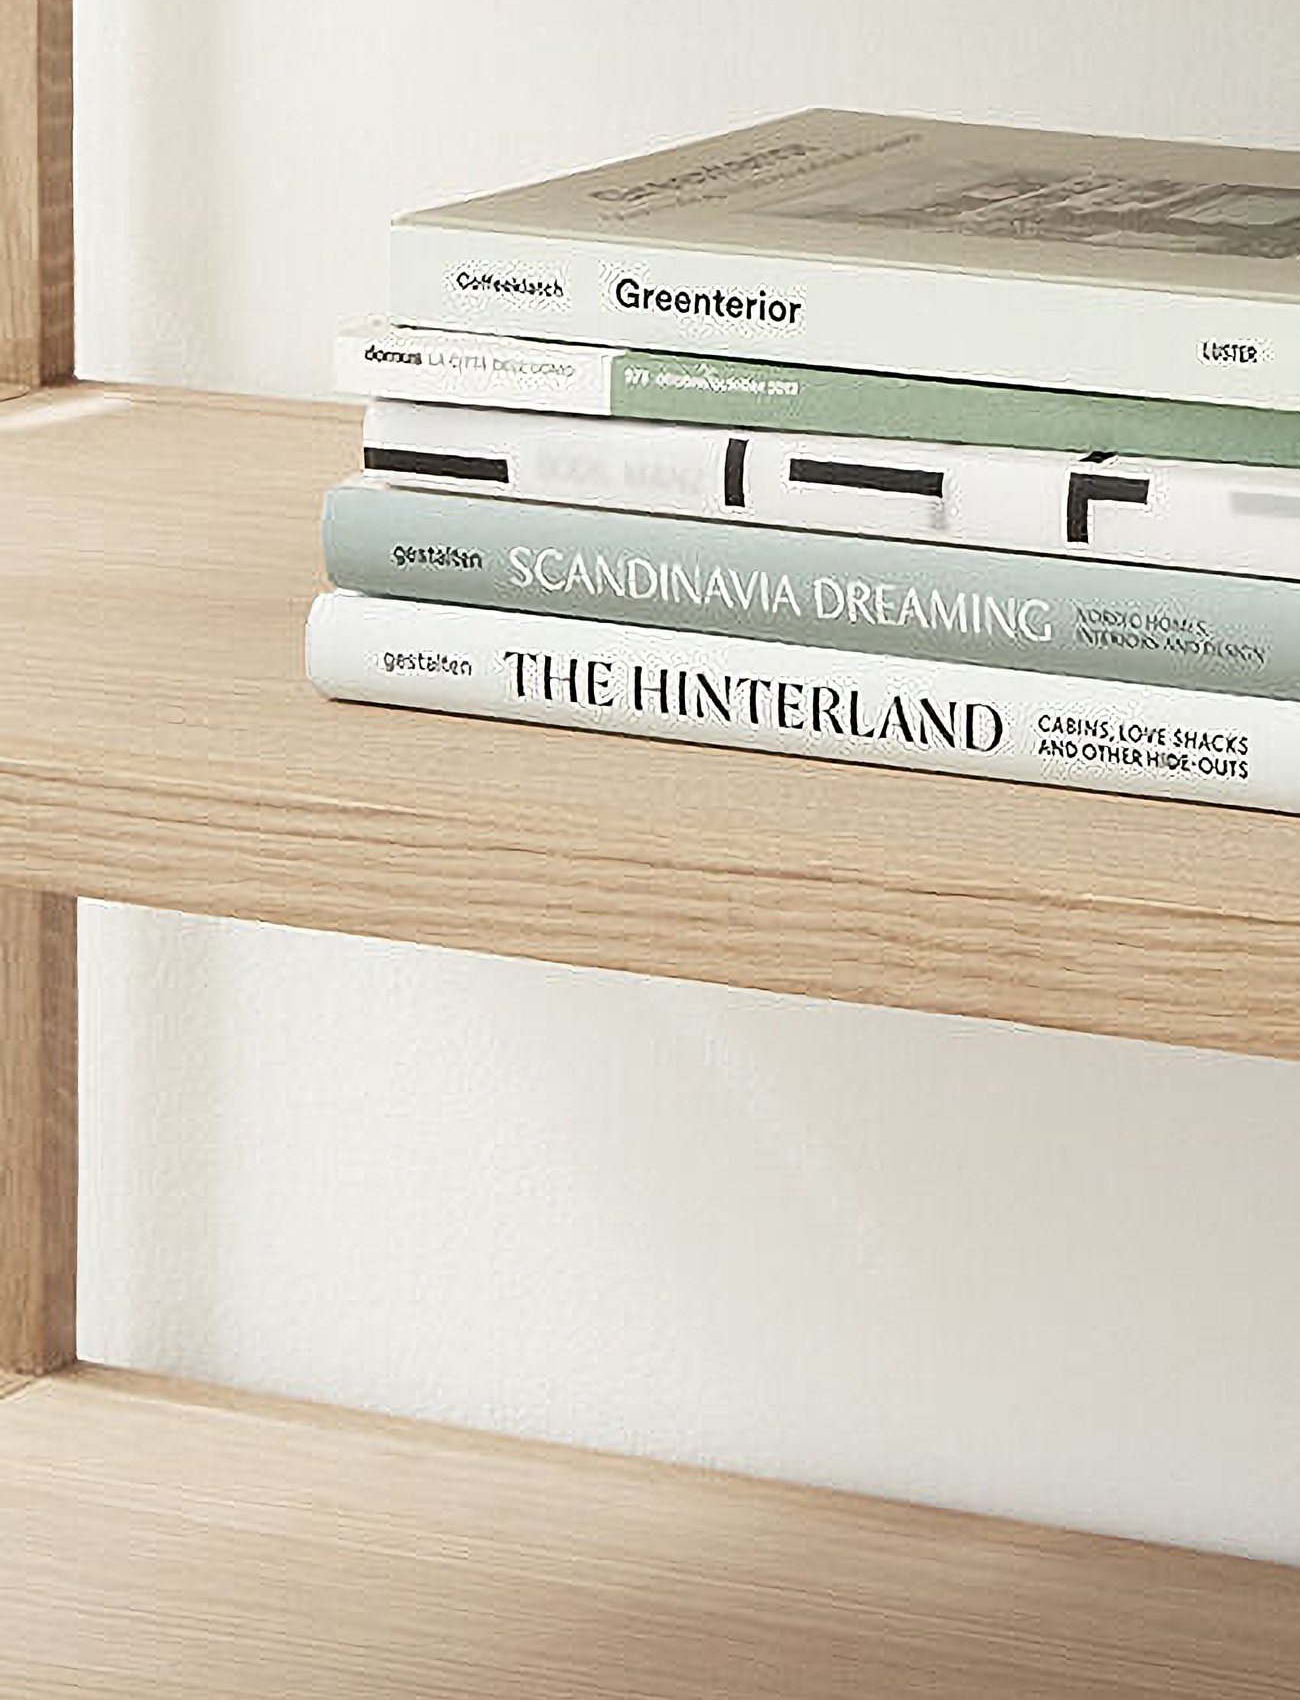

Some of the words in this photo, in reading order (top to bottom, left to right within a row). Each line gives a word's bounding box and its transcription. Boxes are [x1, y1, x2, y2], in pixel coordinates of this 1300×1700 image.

[615, 277, 802, 324] Greenterior
[1202, 341, 1258, 363] LUSTER
[393, 545, 483, 569] gestalten
[509, 545, 802, 617] SCANDINAVIA
[814, 577, 1053, 643] DREAMING
[384, 651, 472, 676] gestalten
[502, 650, 614, 707] THE
[634, 664, 1005, 753] HINTERLAND
[1038, 714, 1115, 742] CABINS,
[1119, 724, 1167, 746] LOVE
[1173, 728, 1249, 756] SHACKS
[1038, 738, 1078, 759] AND
[1082, 743, 1144, 768] OTHER
[1147, 750, 1249, 779] HIDE-OUTS
